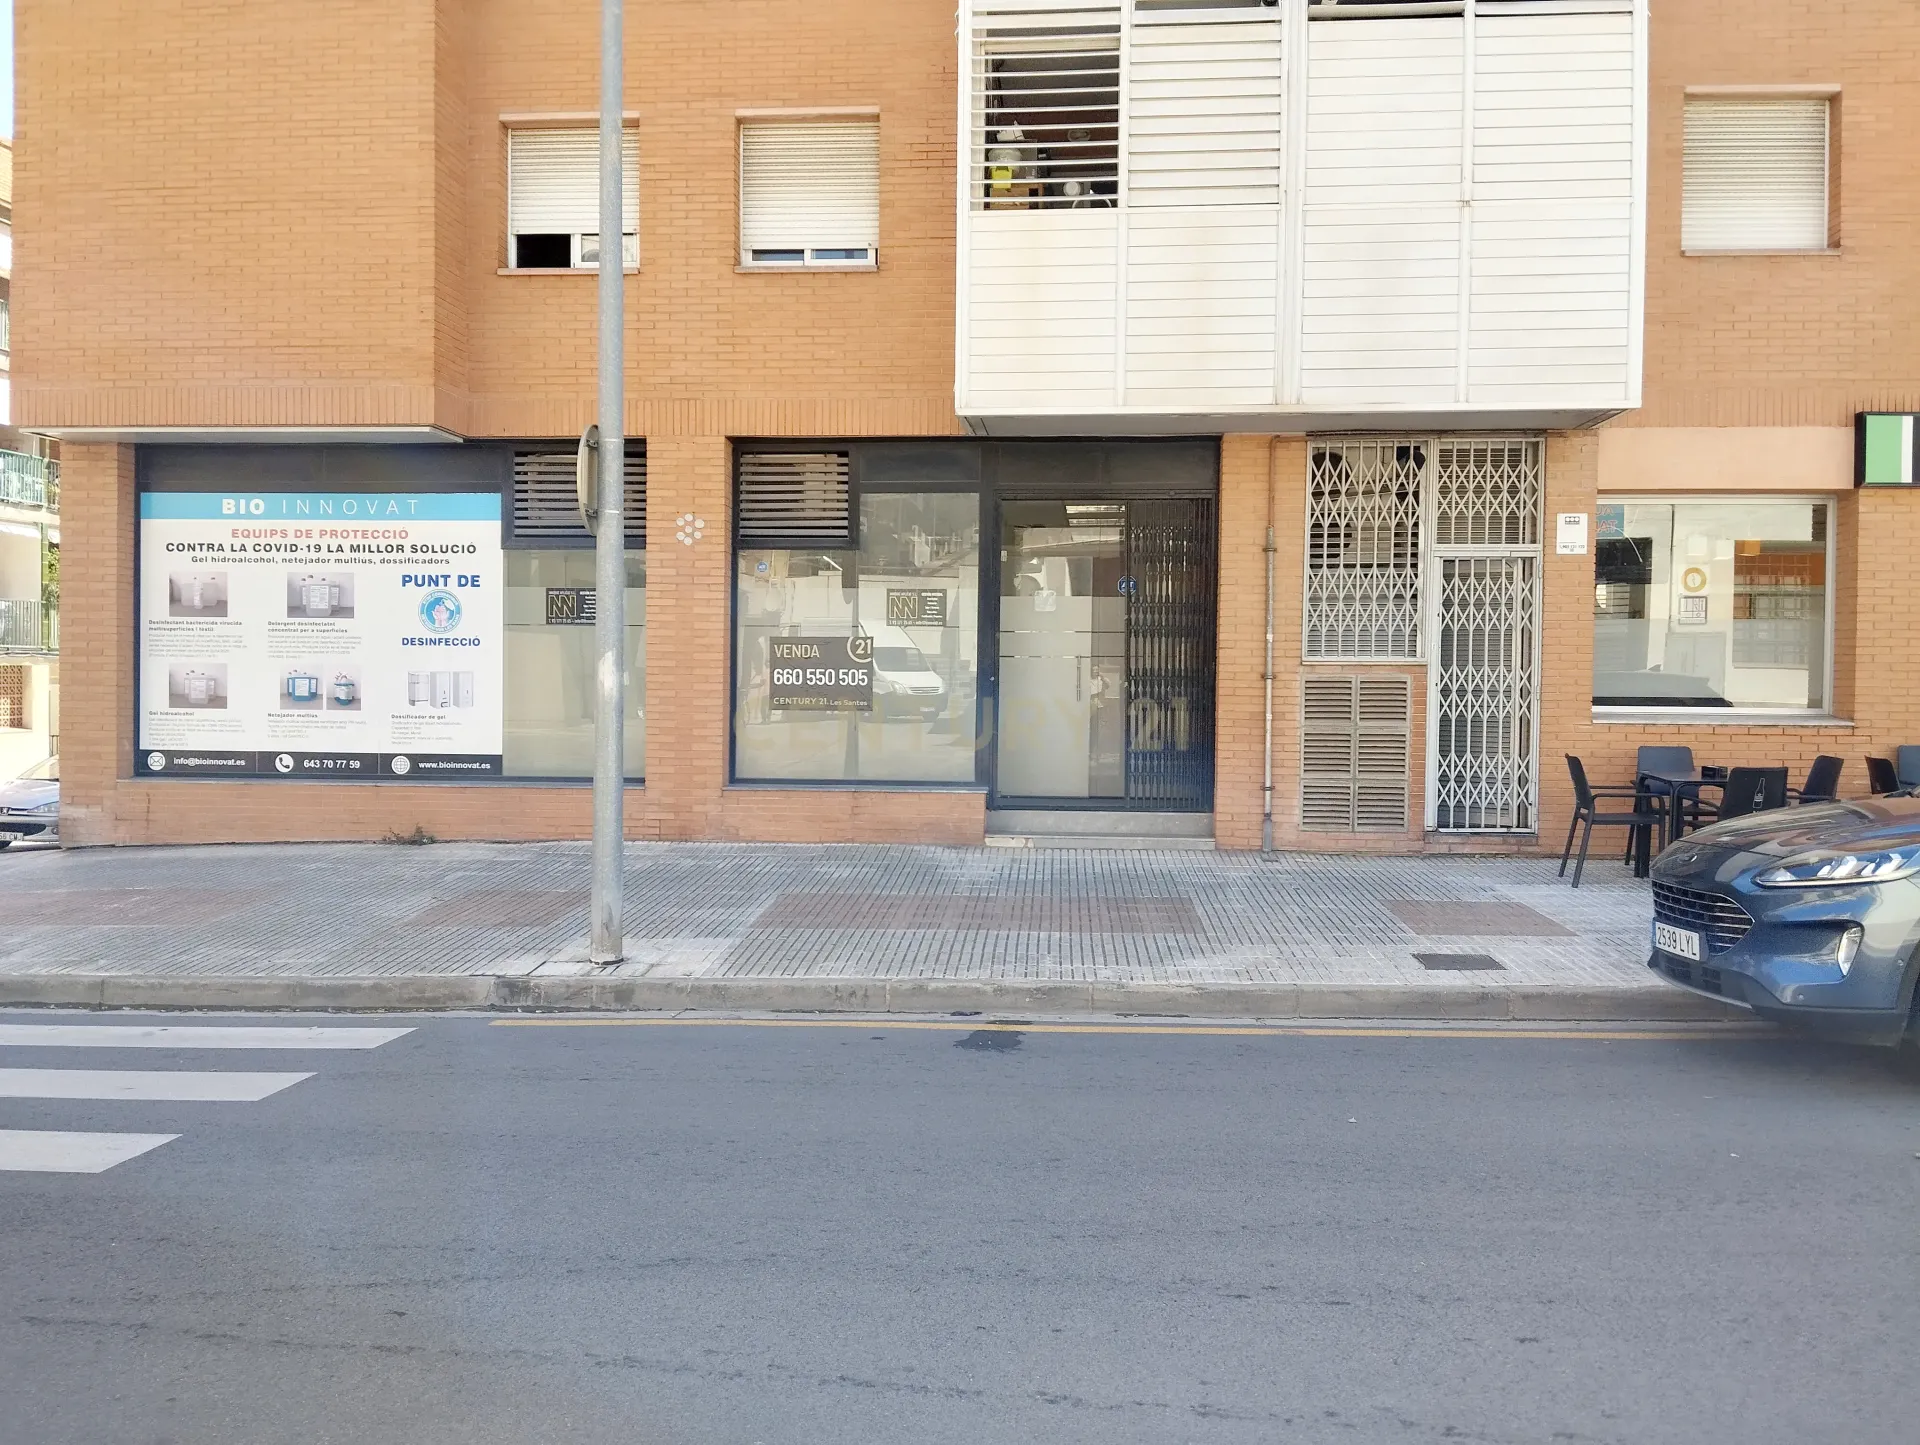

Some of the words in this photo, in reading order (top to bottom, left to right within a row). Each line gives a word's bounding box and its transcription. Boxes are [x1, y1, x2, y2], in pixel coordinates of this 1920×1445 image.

[222, 498, 265, 515] BIO
[282, 499, 418, 515] INNOVAT
[231, 528, 288, 540] EQUIPS
[294, 529, 313, 539] DE
[319, 527, 409, 540] PROTECCIÓ
[166, 542, 225, 553] CONTRA
[230, 543, 248, 553] LA
[252, 543, 322, 553] COVID-19
[327, 544, 344, 554] LA
[350, 544, 405, 554] MILLOR
[410, 542, 477, 554] SOLUCIÓ
[191, 555, 208, 563] Gel
[211, 555, 278, 564] hidroalcohol,
[281, 556, 331, 565] netejador
[380, 557, 450, 565] dossificadors
[401, 574, 451, 588] PUNT
[457, 574, 481, 588] DE
[401, 635, 481, 647] DESINFECCIÓ
[774, 644, 820, 658] VENDA
[855, 639, 872, 655] 21
[773, 668, 803, 685] 660
[806, 668, 836, 686] 550
[839, 669, 868, 686] 505
[773, 697, 817, 705] CENTURY
[173, 757, 246, 767] info@bioinnovat.es
[303, 759, 320, 768] 643
[322, 760, 334, 768] 70
[336, 760, 347, 768] 77
[349, 760, 361, 769] 59
[417, 761, 491, 769] www.bioinnovat.es
[1657, 926, 1677, 949] 2539
[1680, 932, 1697, 956] LYL
